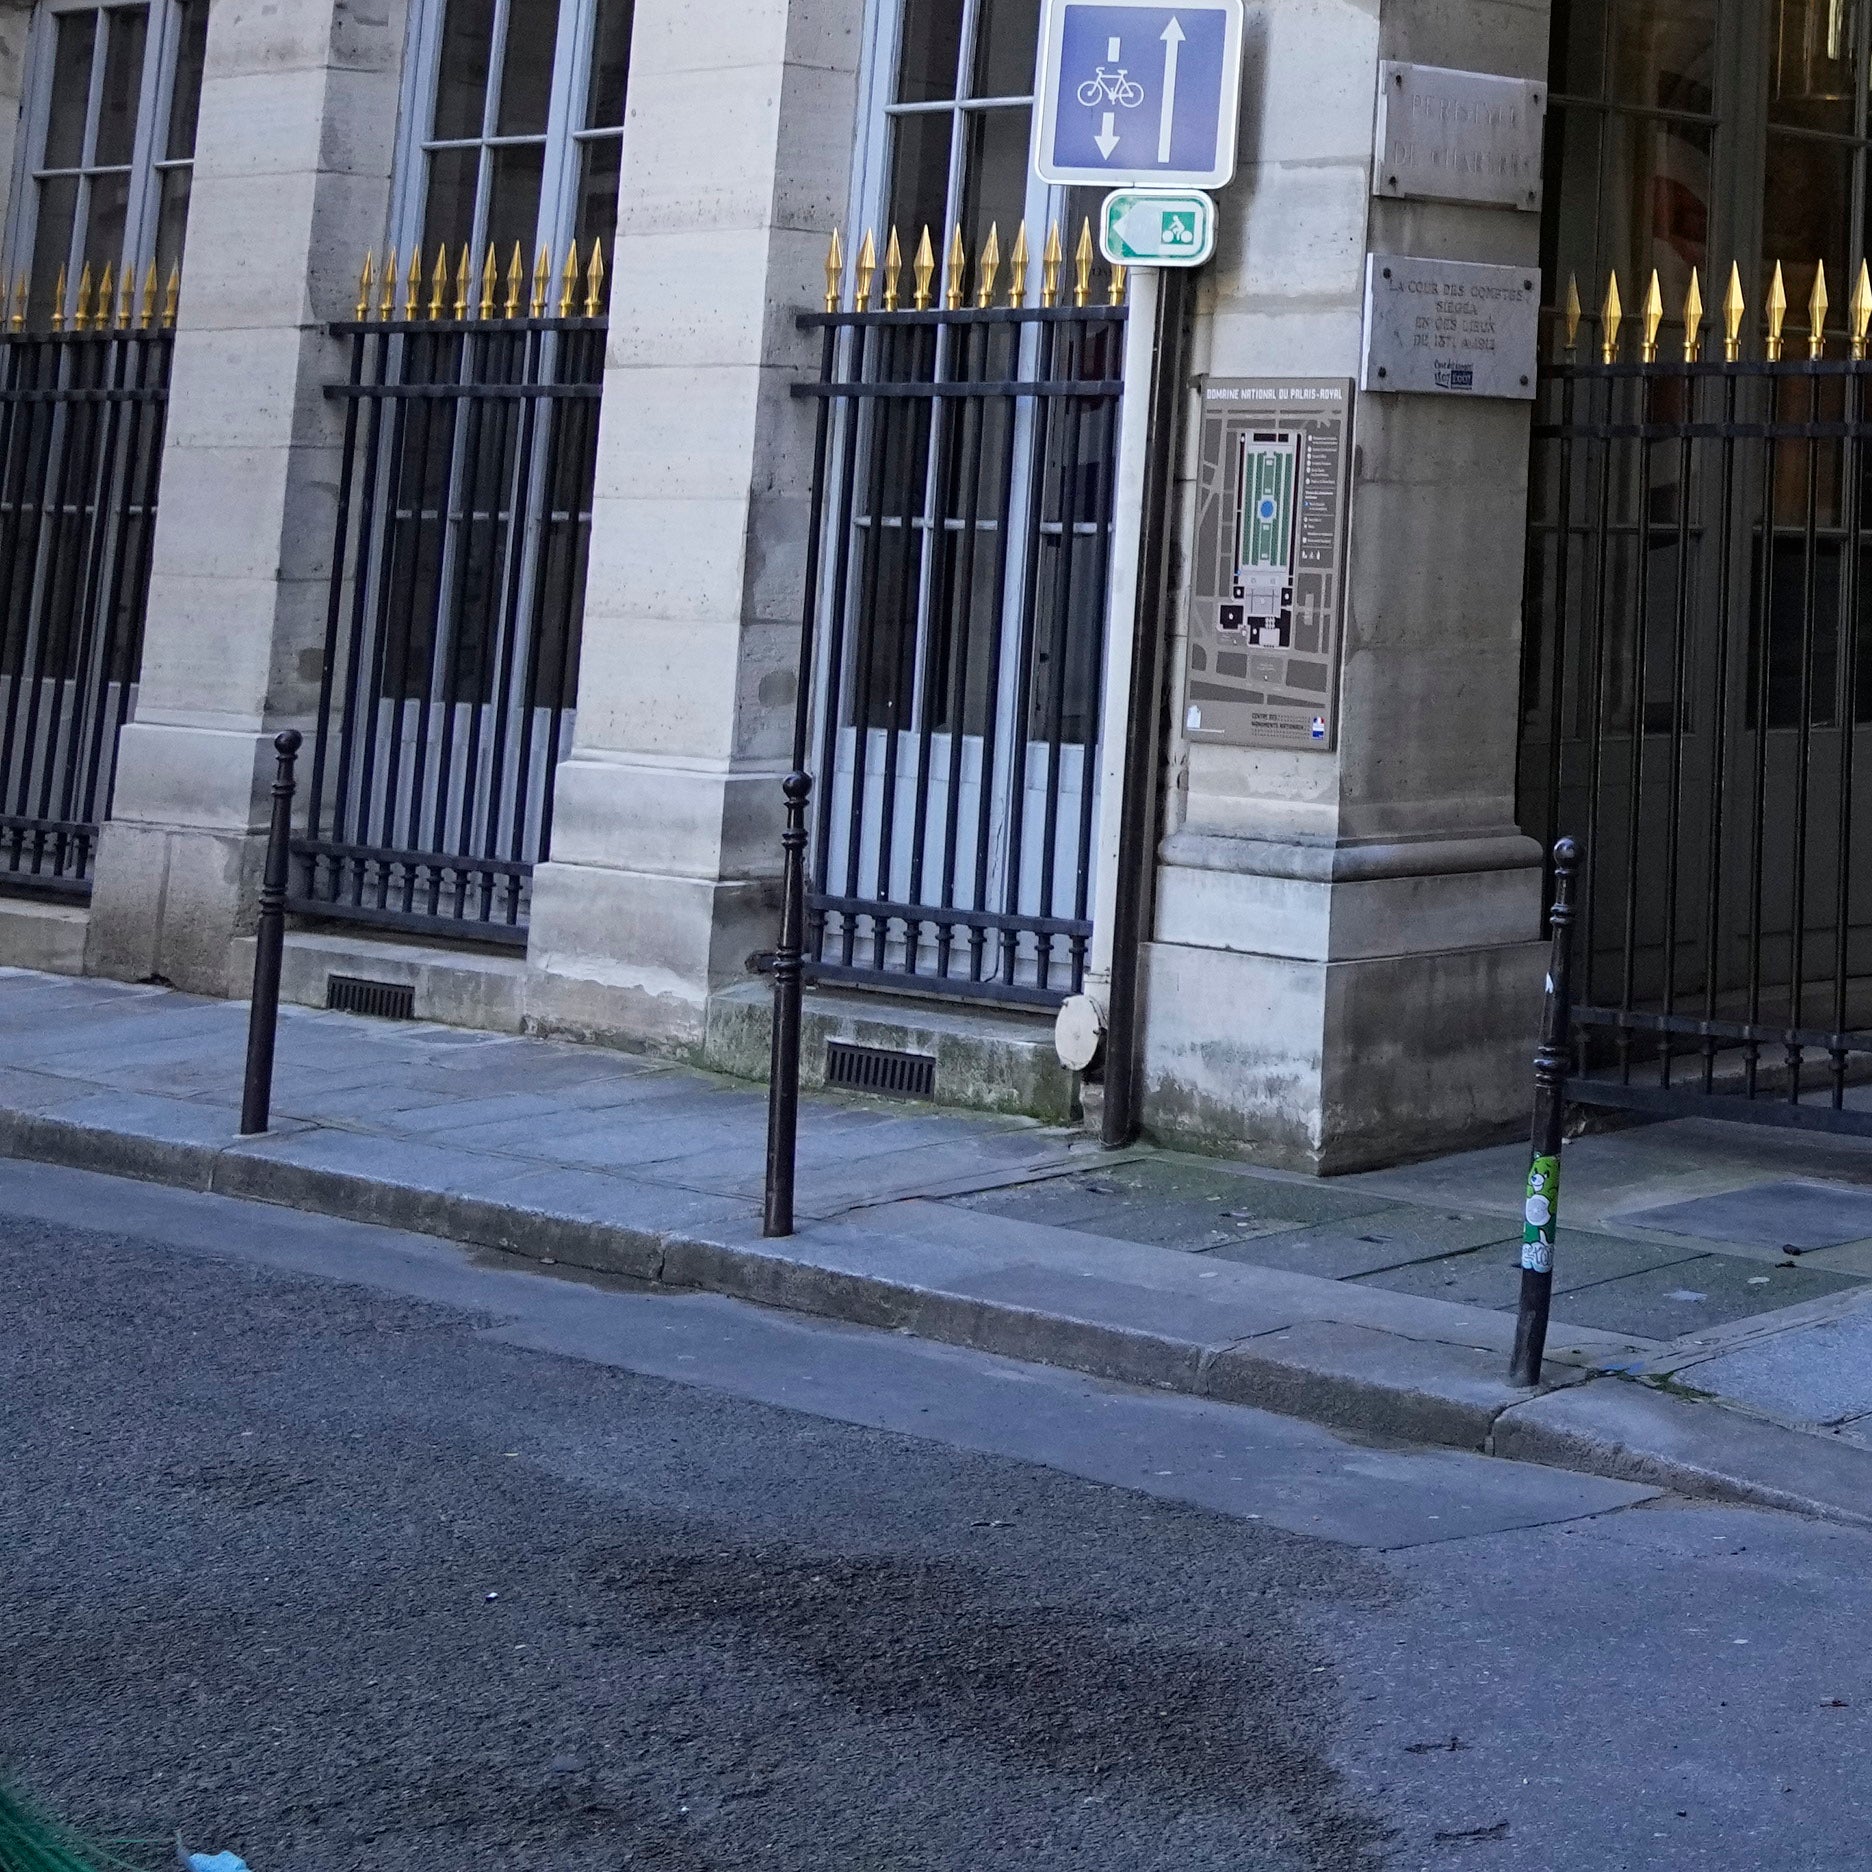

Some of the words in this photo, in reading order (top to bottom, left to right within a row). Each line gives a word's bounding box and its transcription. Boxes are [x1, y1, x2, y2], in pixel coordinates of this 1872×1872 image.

[1408, 280, 1439, 296] COUR
[1443, 284, 1464, 296] DES
[1206, 388, 1239, 400] DOMAINE
[1241, 388, 1277, 400] NATIONAL
[1279, 388, 1289, 400] DU
